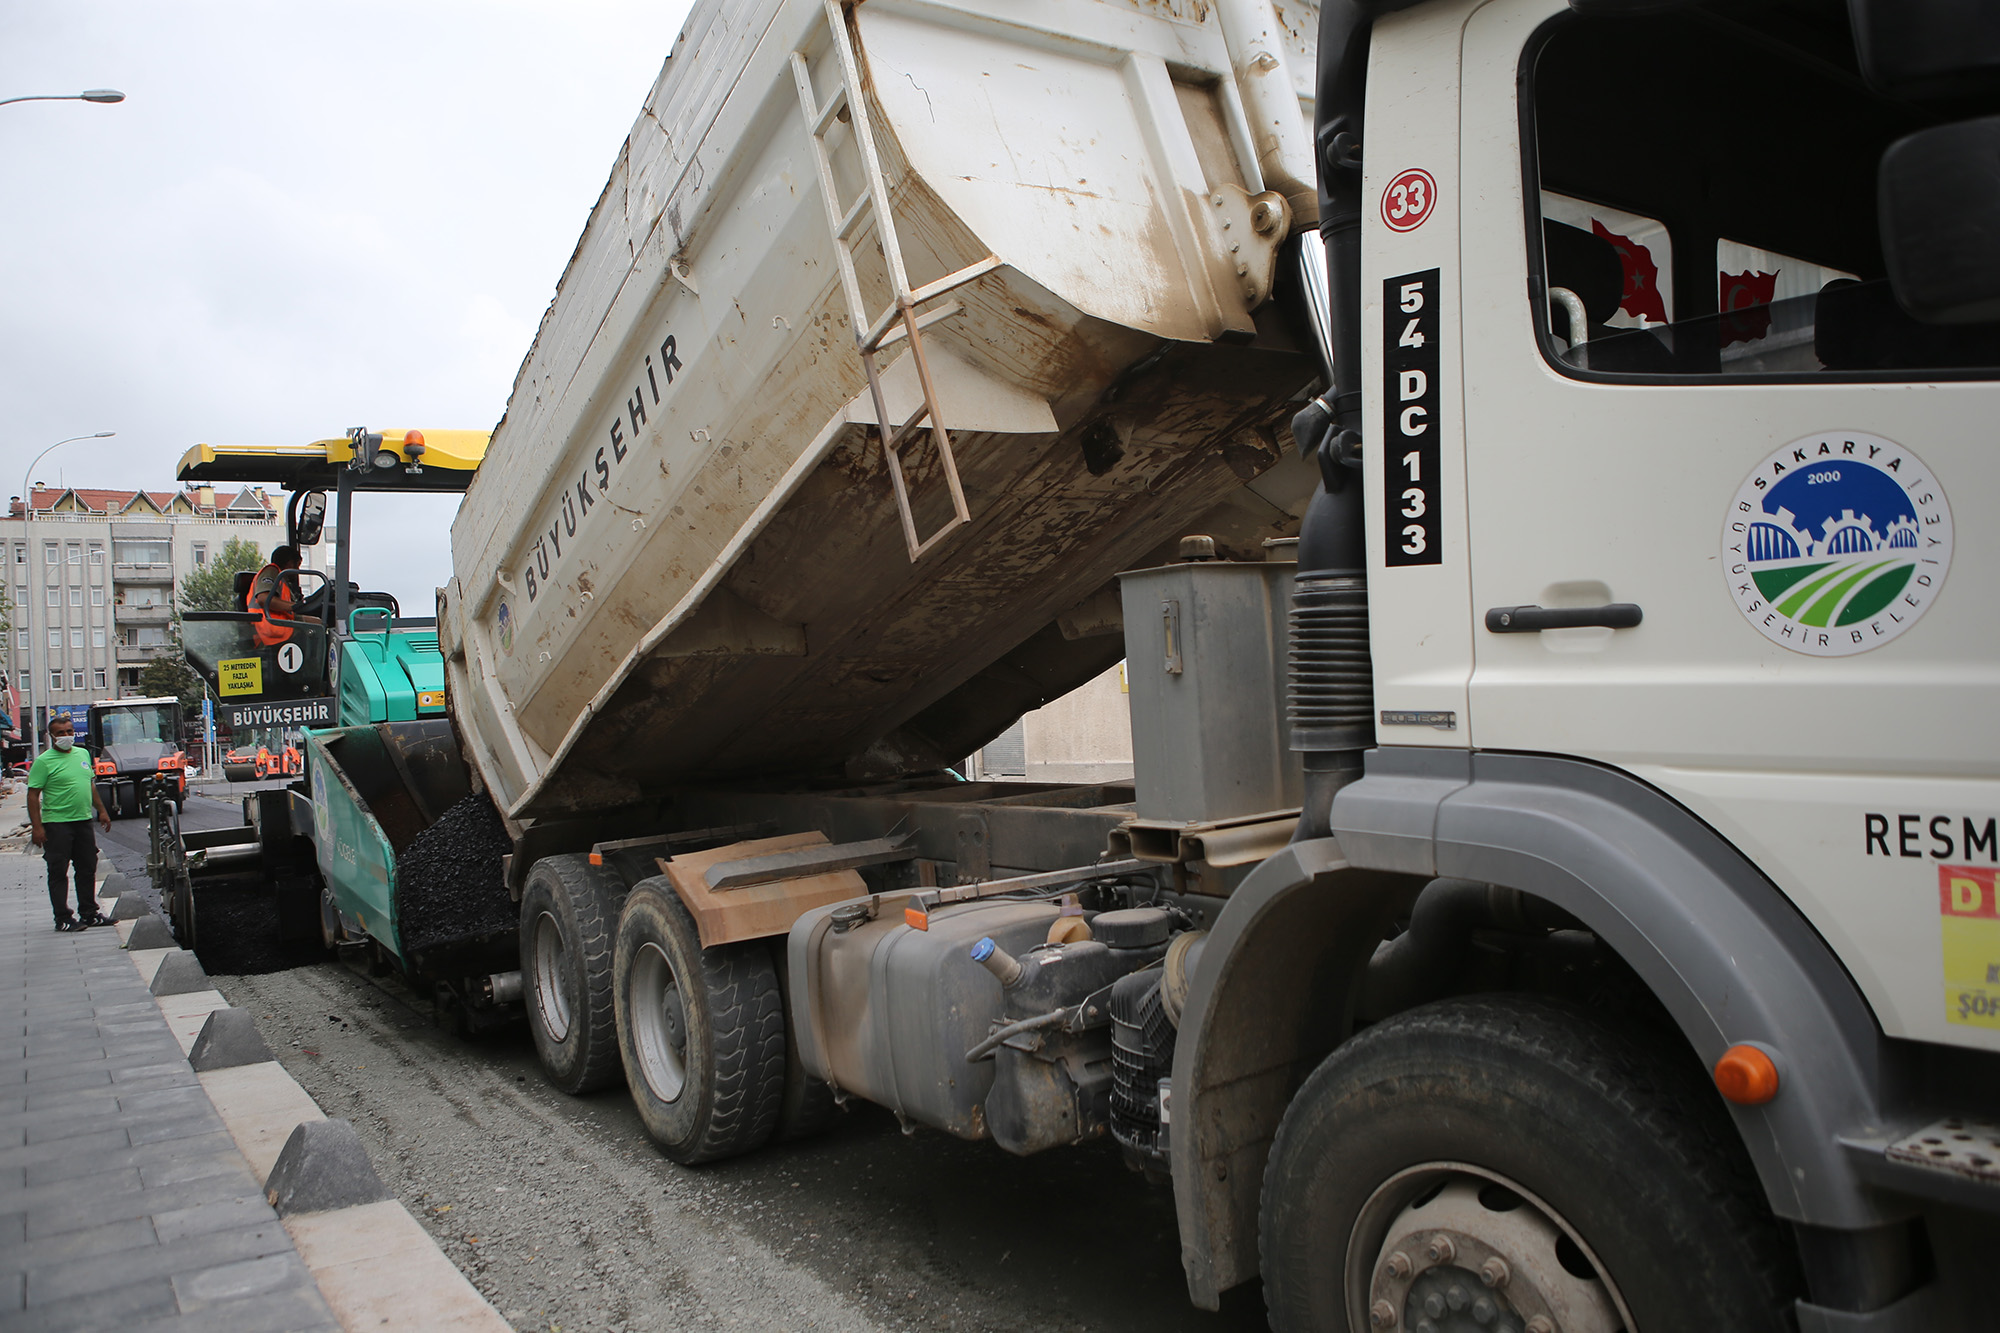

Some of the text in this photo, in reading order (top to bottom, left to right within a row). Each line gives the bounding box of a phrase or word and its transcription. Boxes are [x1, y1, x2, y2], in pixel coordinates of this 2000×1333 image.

[1391, 180, 1425, 219] 33
[525, 334, 683, 603] BÜYÜKŞEHİR
[1754, 441, 1902, 490] SAKARYA
[1807, 470, 1841, 485] 2000
[1730, 478, 1942, 647] BÜYÜKŞEHİR BELEDİYESİ
[231, 662, 257, 671] METREDEN
[283, 646, 294, 670] 1
[227, 681, 254, 690] YAKLAŞMA
[232, 672, 248, 680] FAZLA
[233, 701, 329, 726] BÜYÜKŞEHİR
